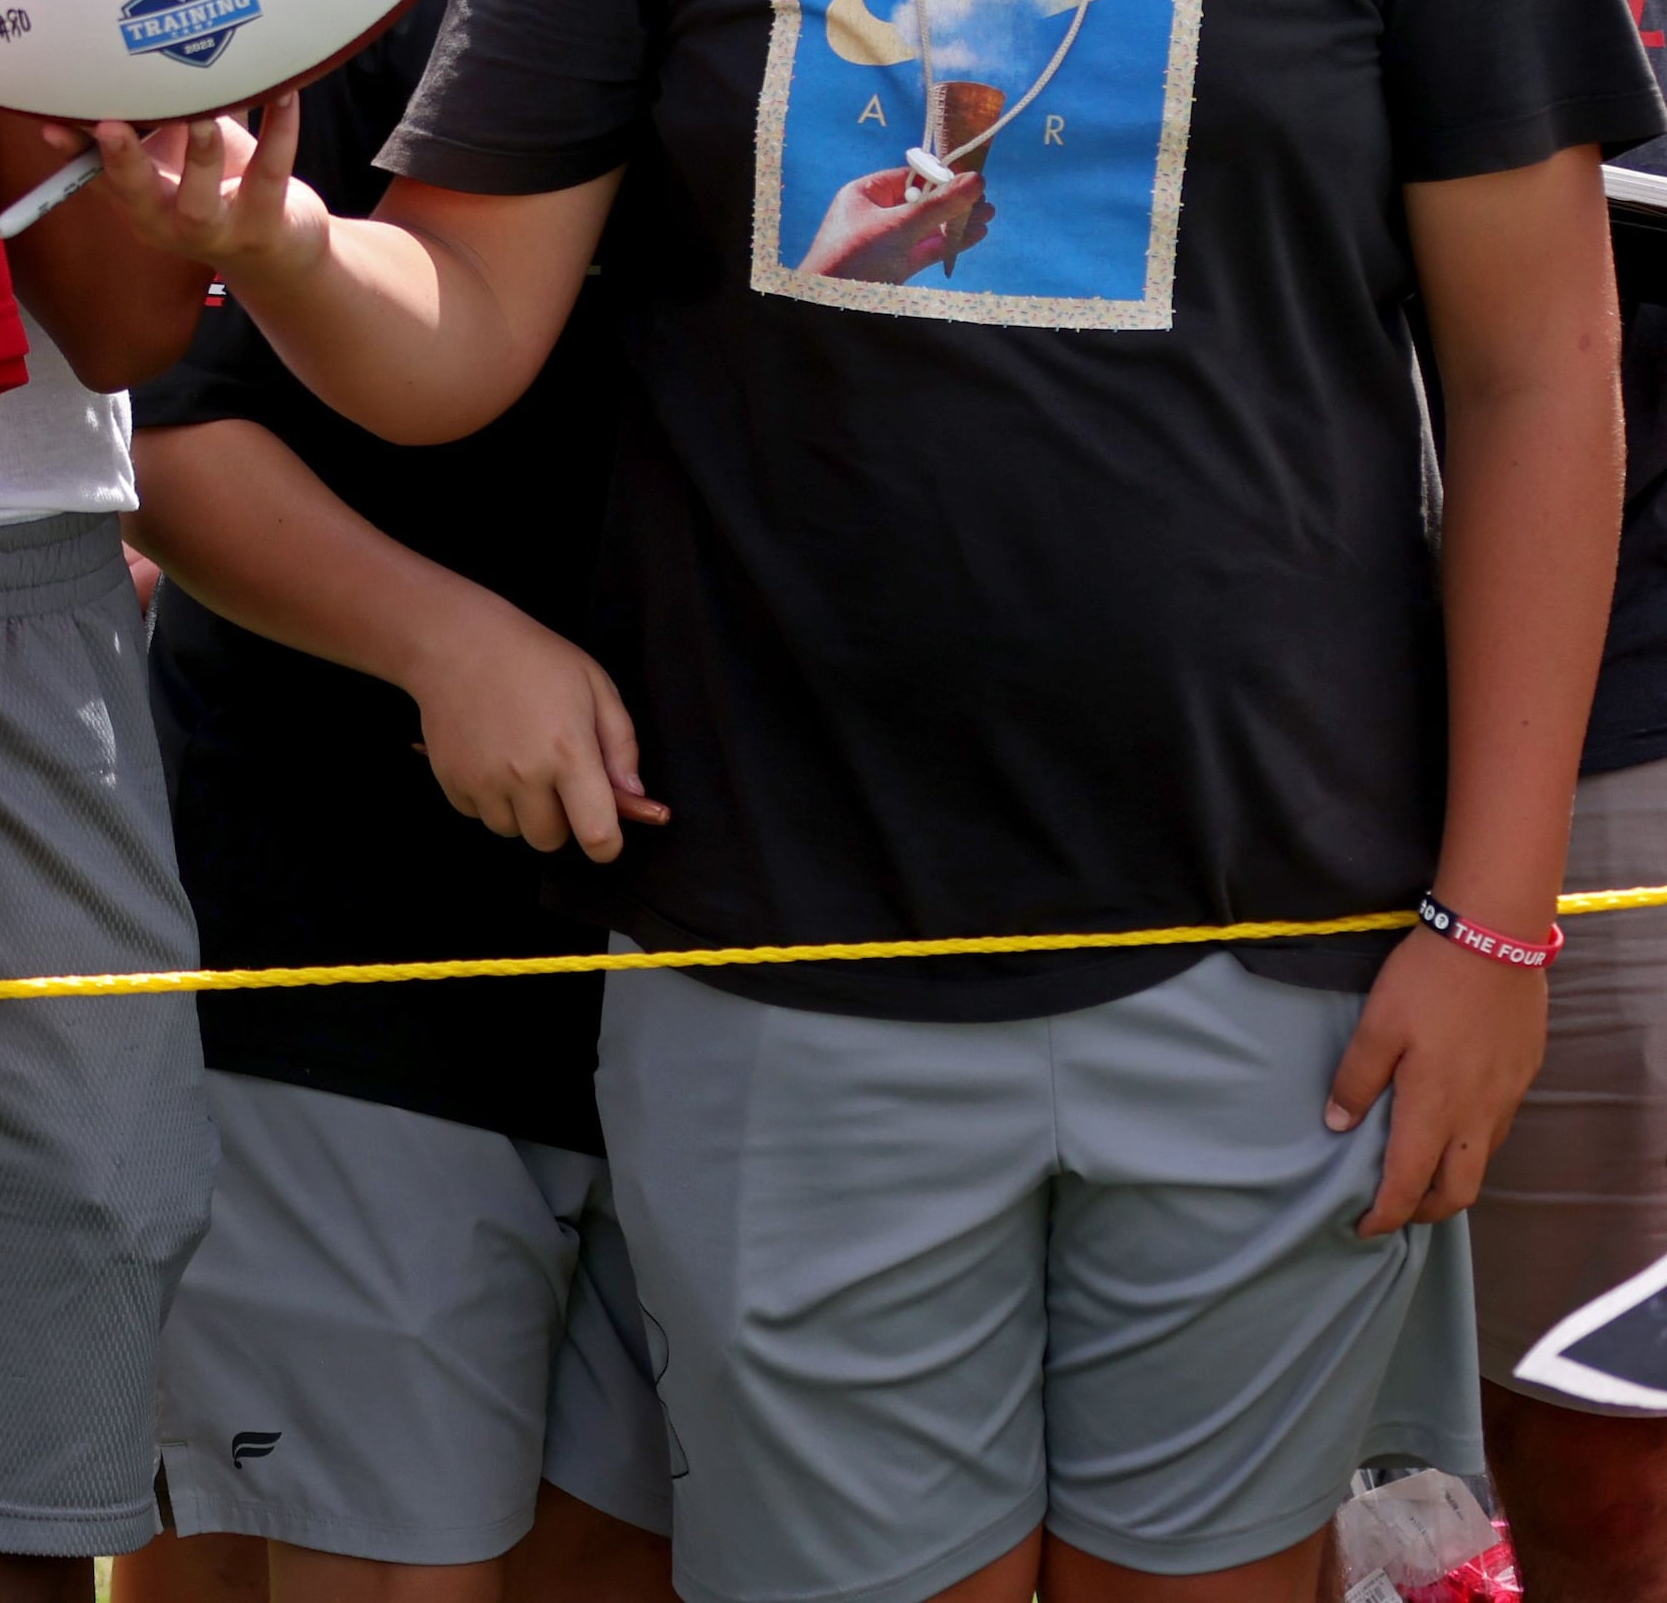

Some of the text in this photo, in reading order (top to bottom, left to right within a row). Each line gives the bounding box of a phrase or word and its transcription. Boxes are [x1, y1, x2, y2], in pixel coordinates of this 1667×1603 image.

[184, 37, 216, 55] 2022
[857, 94, 1066, 145] A R
[1454, 922, 1547, 967] THE FOUR
